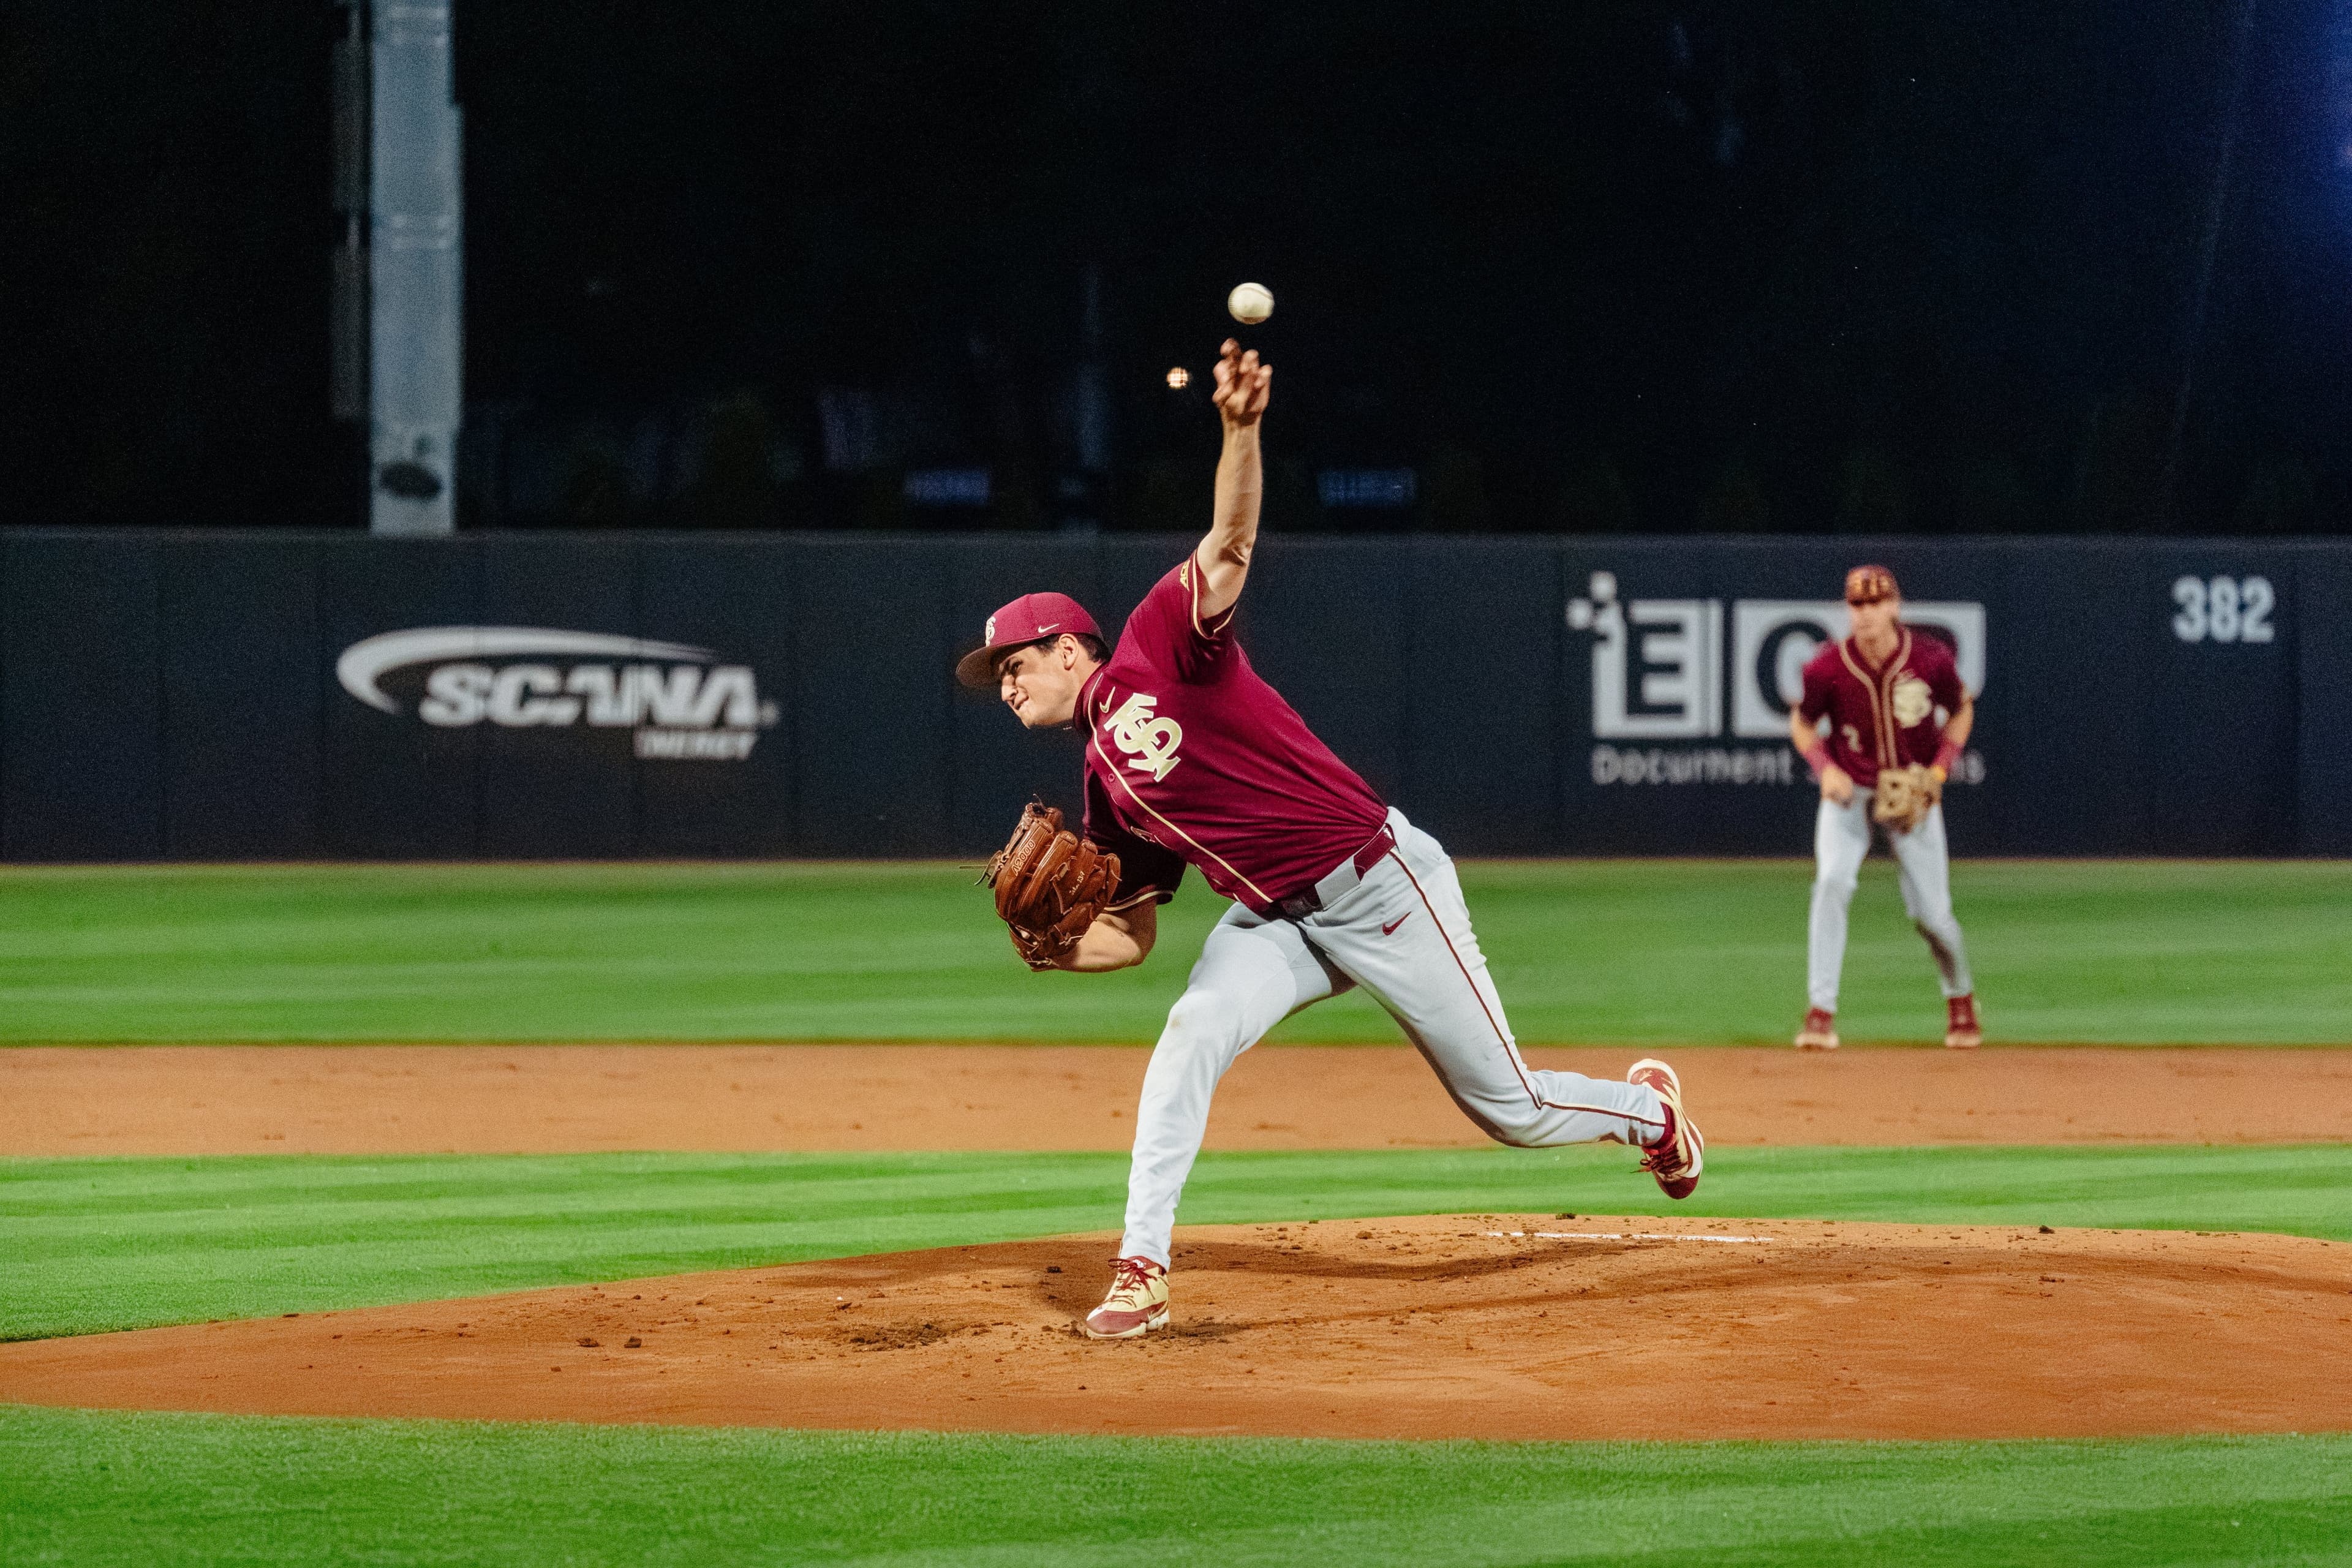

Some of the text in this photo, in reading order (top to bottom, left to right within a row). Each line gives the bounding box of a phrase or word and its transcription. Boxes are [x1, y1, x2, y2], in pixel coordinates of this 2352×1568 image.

[2173, 575, 2275, 642] 382
[419, 665, 756, 727] SCANA
[1593, 745, 1793, 785] Document
[1011, 839, 1036, 876] A2000
